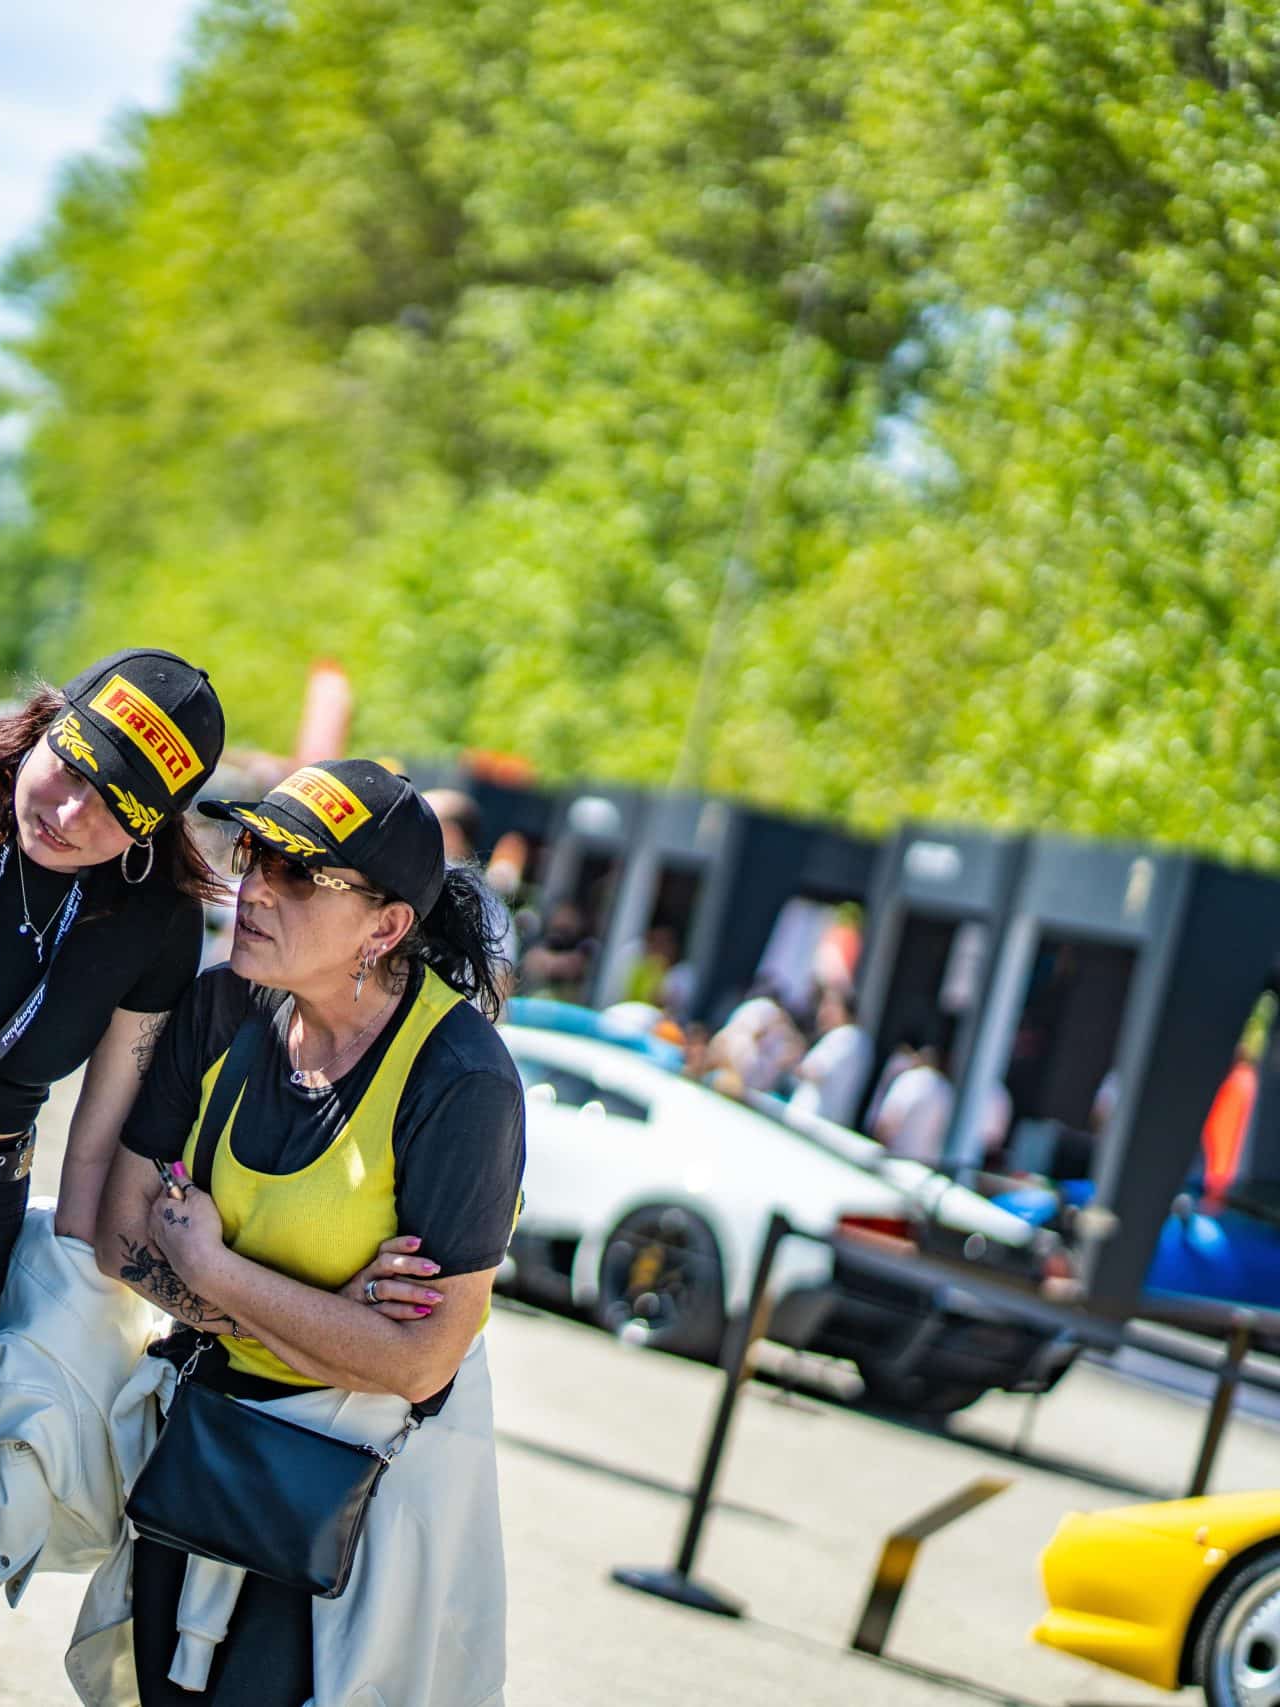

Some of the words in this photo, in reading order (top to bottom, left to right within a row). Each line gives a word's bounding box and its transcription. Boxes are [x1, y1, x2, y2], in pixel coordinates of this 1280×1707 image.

[104, 688, 191, 779] PIRELLI
[282, 773, 355, 824] RELLI
[1, 983, 46, 1047] Lamborghini
